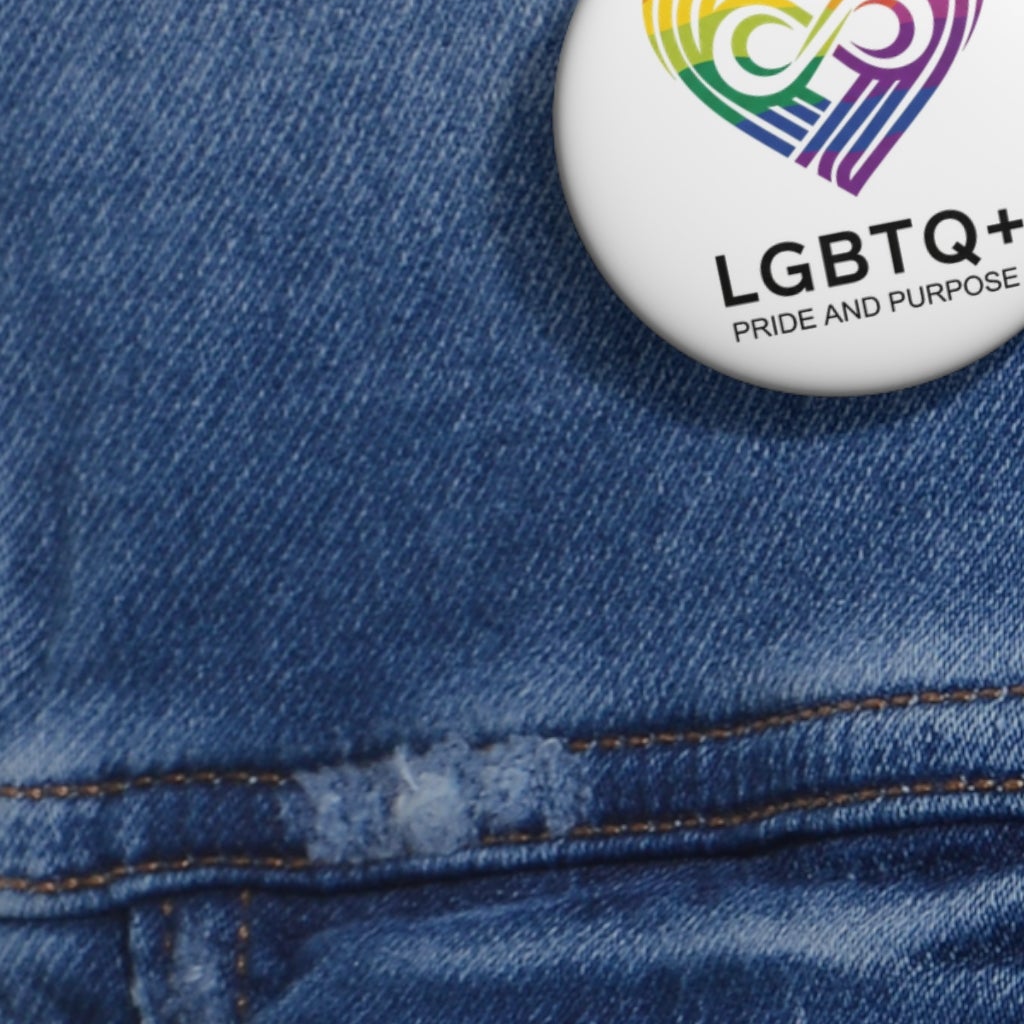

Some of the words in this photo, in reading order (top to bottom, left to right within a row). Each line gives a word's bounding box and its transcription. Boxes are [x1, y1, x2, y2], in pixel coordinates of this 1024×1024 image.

[715, 209, 1024, 308] LGBTQ+
[732, 308, 817, 343] PRIDE
[824, 296, 881, 326] AND
[888, 266, 1021, 313] PURPOSE
